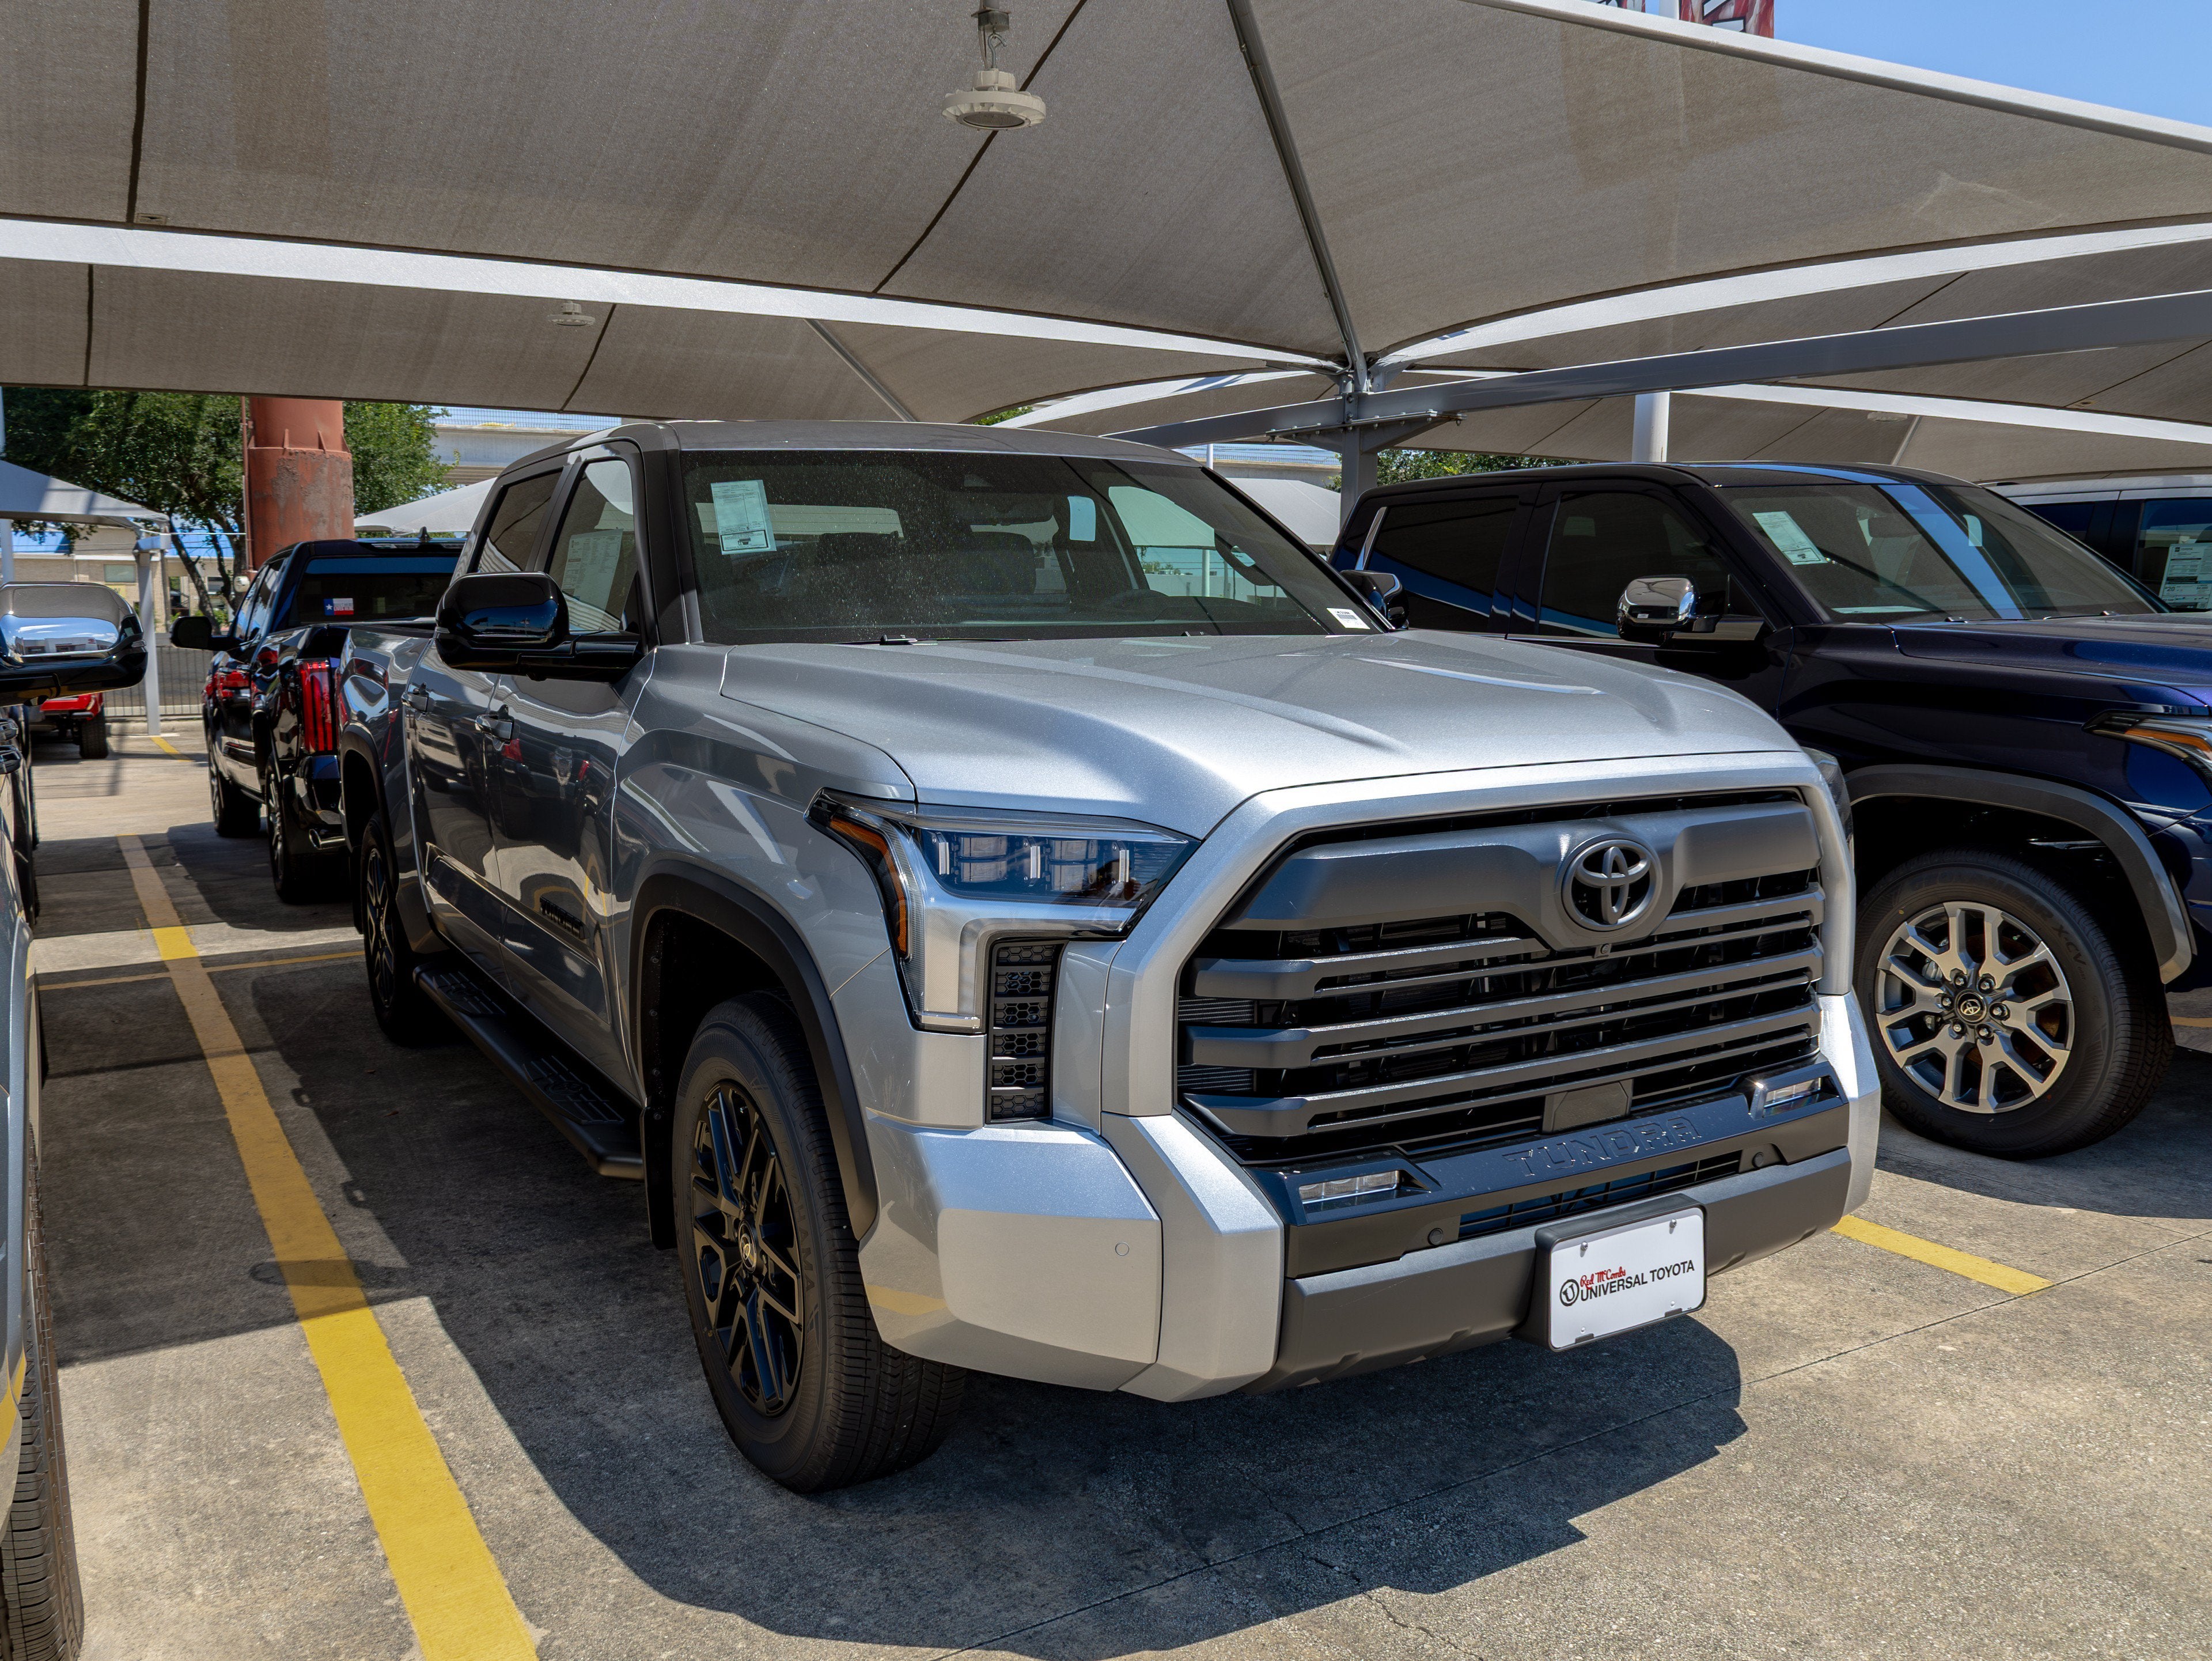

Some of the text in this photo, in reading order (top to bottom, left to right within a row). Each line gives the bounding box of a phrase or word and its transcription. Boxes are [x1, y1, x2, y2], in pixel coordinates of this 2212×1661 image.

[1501, 1117, 1702, 1177] TUNDRA
[1580, 1266, 1626, 1290] Red McCombs
[1581, 1259, 1695, 1301] UNIVERSAL TOYOTA
